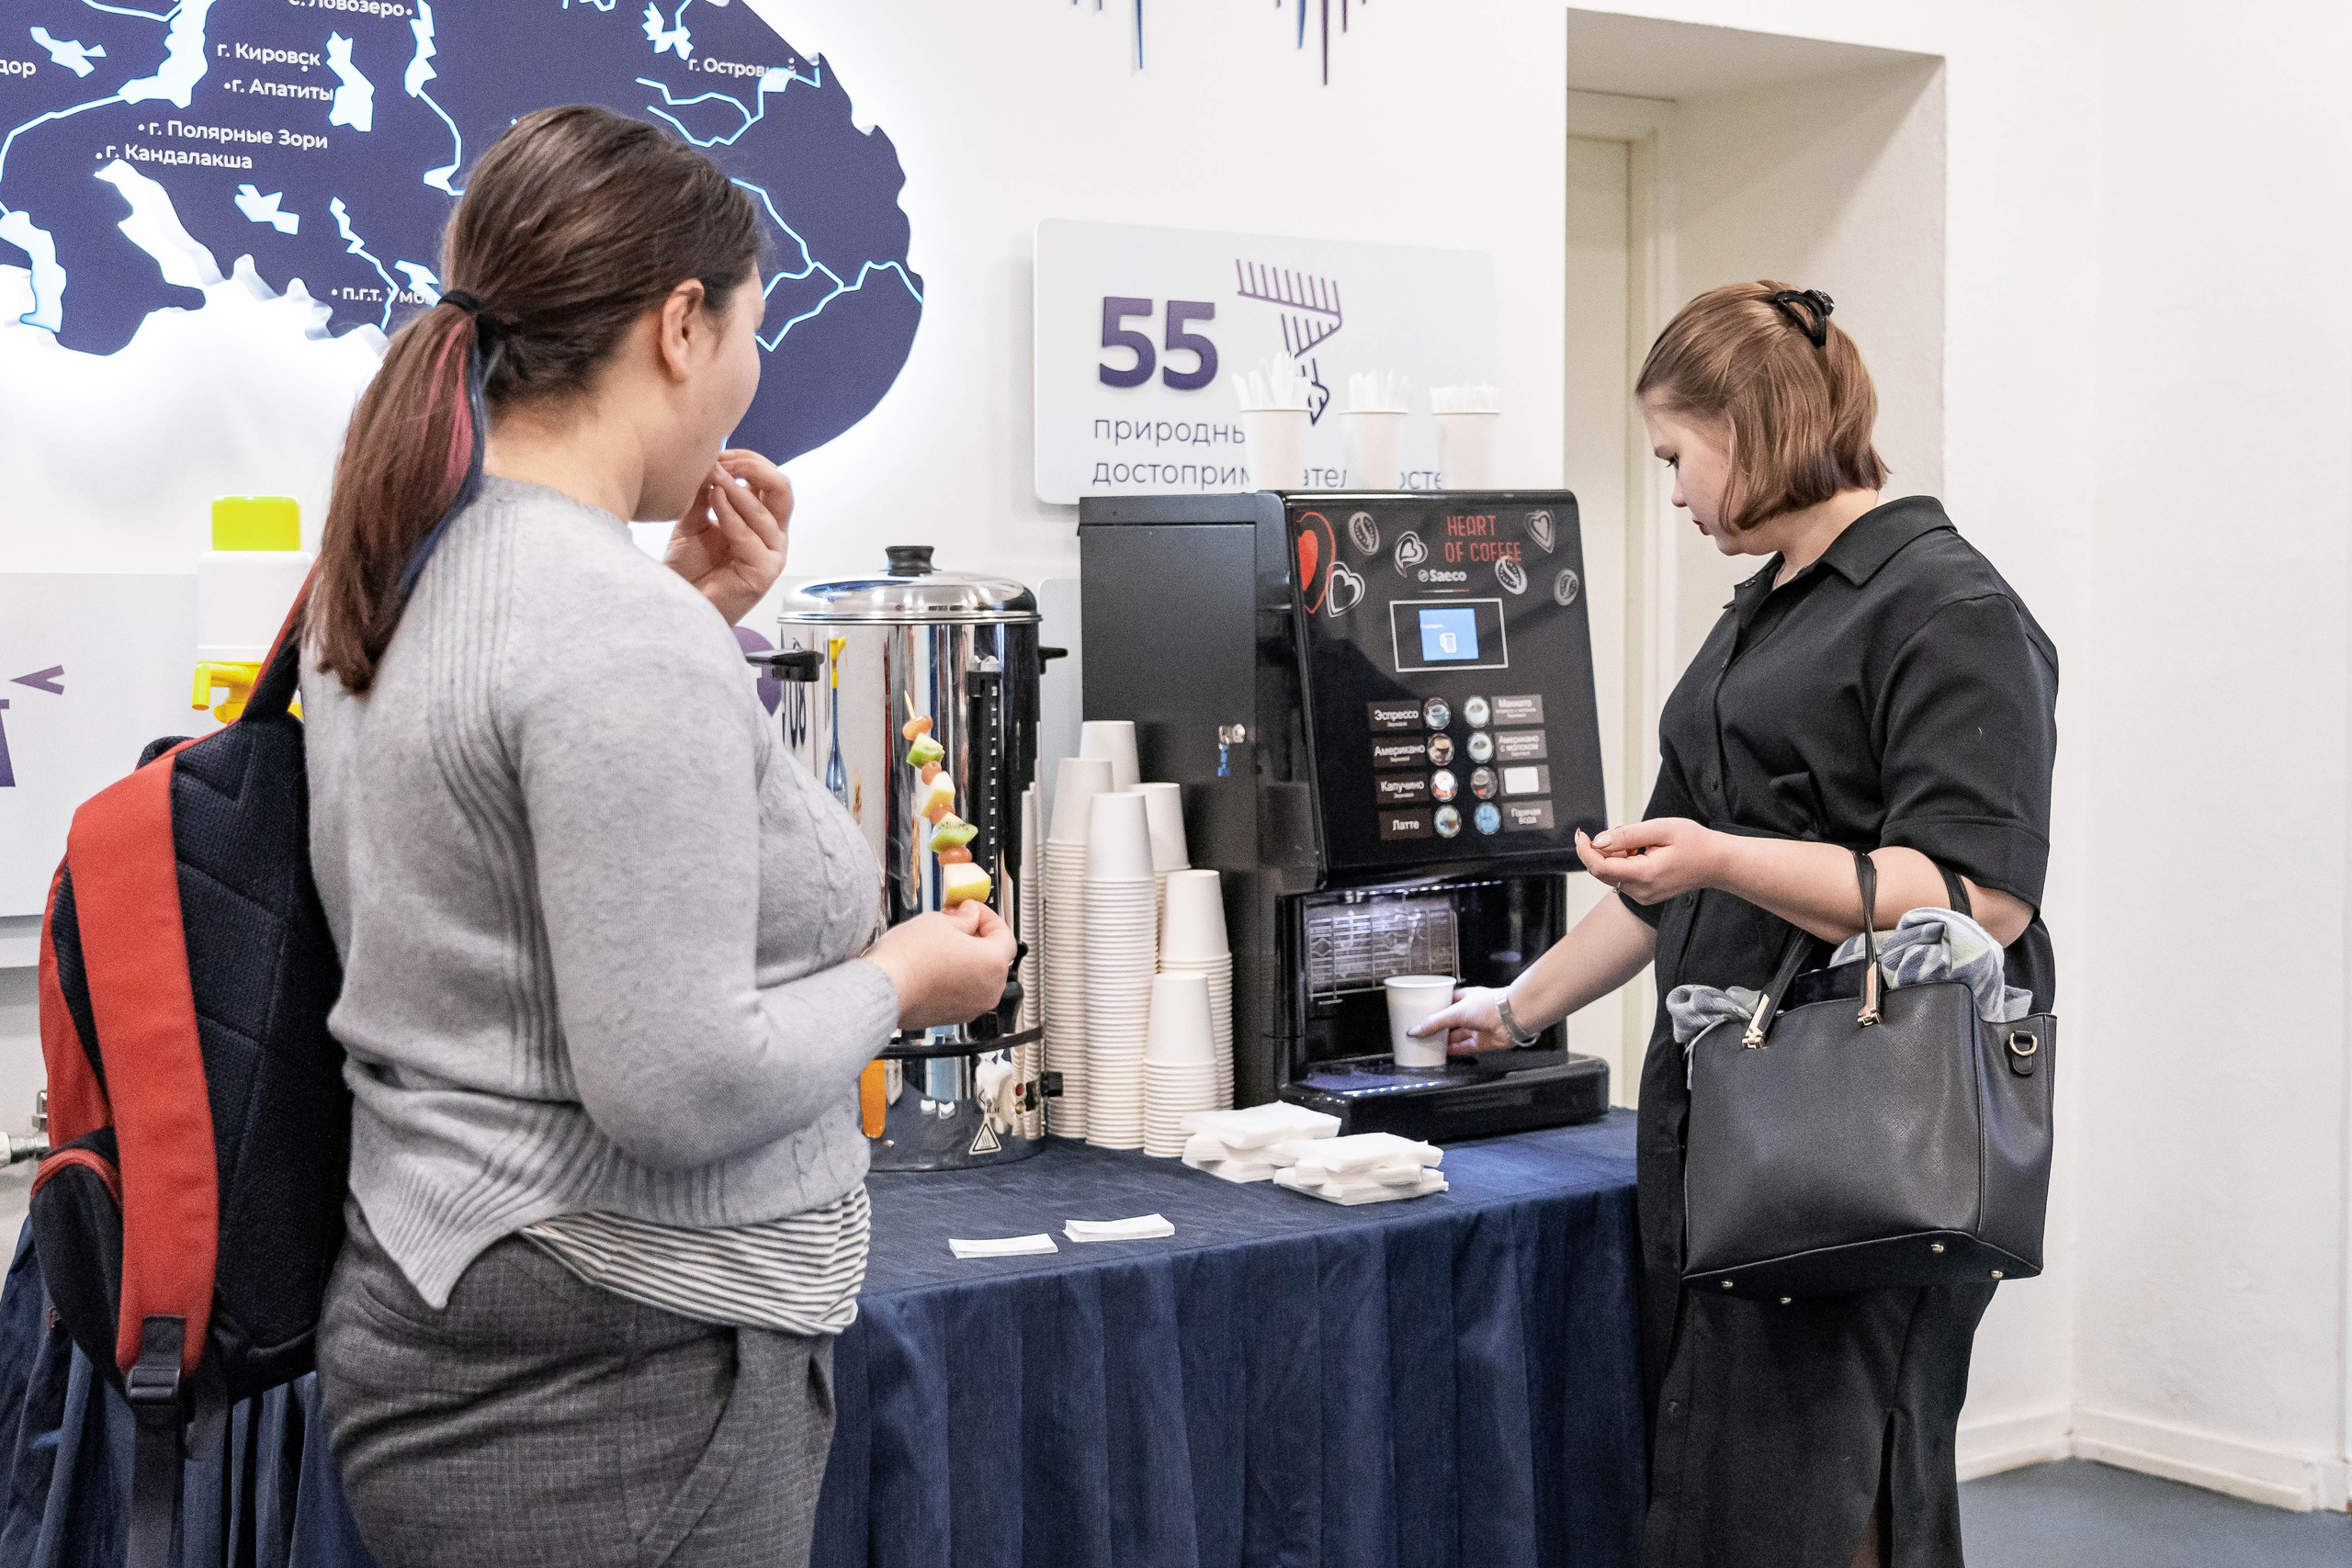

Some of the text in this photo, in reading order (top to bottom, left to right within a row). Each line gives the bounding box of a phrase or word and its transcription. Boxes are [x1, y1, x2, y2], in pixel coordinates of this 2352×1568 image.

[217, 42, 321, 66] г. Кировск
[687, 57, 797, 81] г. Остров
[232, 78, 334, 102] г. Апатиты
[149, 119, 328, 151] г. Полярные Зори
[106, 143, 253, 169] г. Кандалакша
[343, 287, 383, 302] п.г.т.
[1100, 296, 1218, 390] 55
[1446, 515, 1497, 536] HEART
[1444, 541, 1522, 563] OF COFFEE
[1429, 569, 1467, 582] Saeco
[1374, 709, 1419, 722] Эспрессо
[1374, 744, 1426, 757] Американо
[1380, 780, 1425, 793] Капучино
[1392, 819, 1420, 831] Латте
